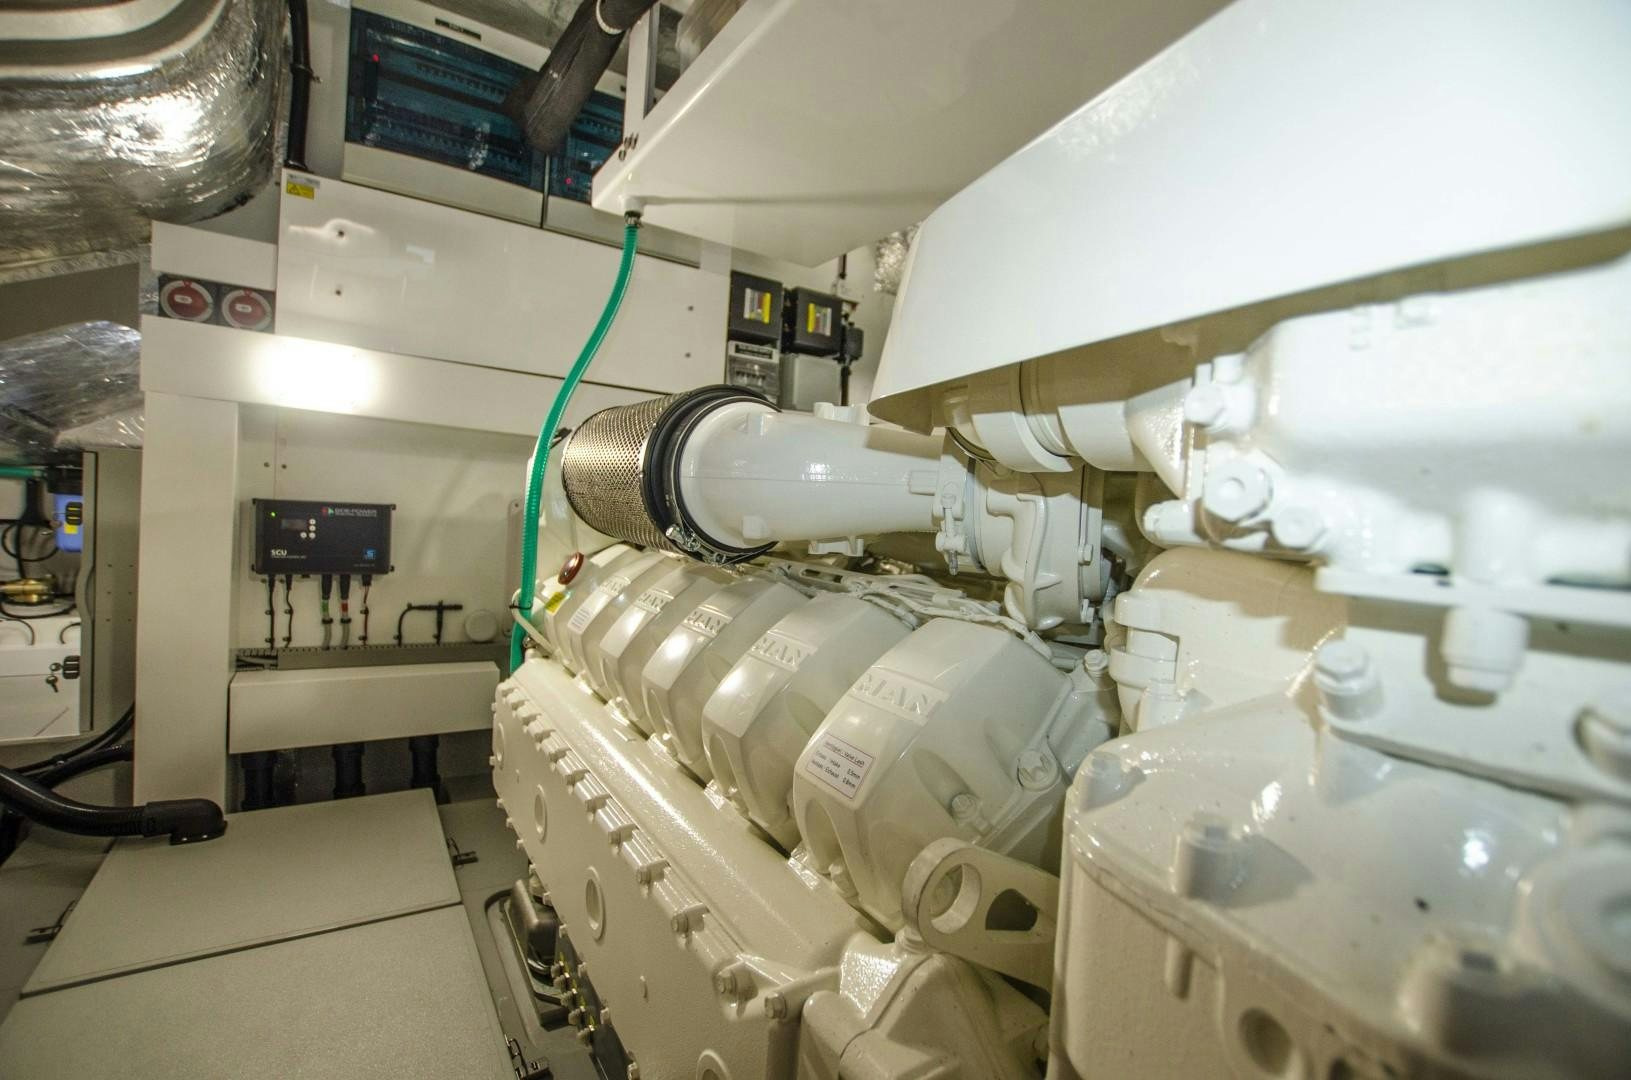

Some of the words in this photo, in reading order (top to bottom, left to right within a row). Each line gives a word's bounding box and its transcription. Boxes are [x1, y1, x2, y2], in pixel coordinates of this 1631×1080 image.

[684, 611, 720, 634] MAN
[751, 638, 800, 666] MAN
[851, 674, 928, 715] MAN
